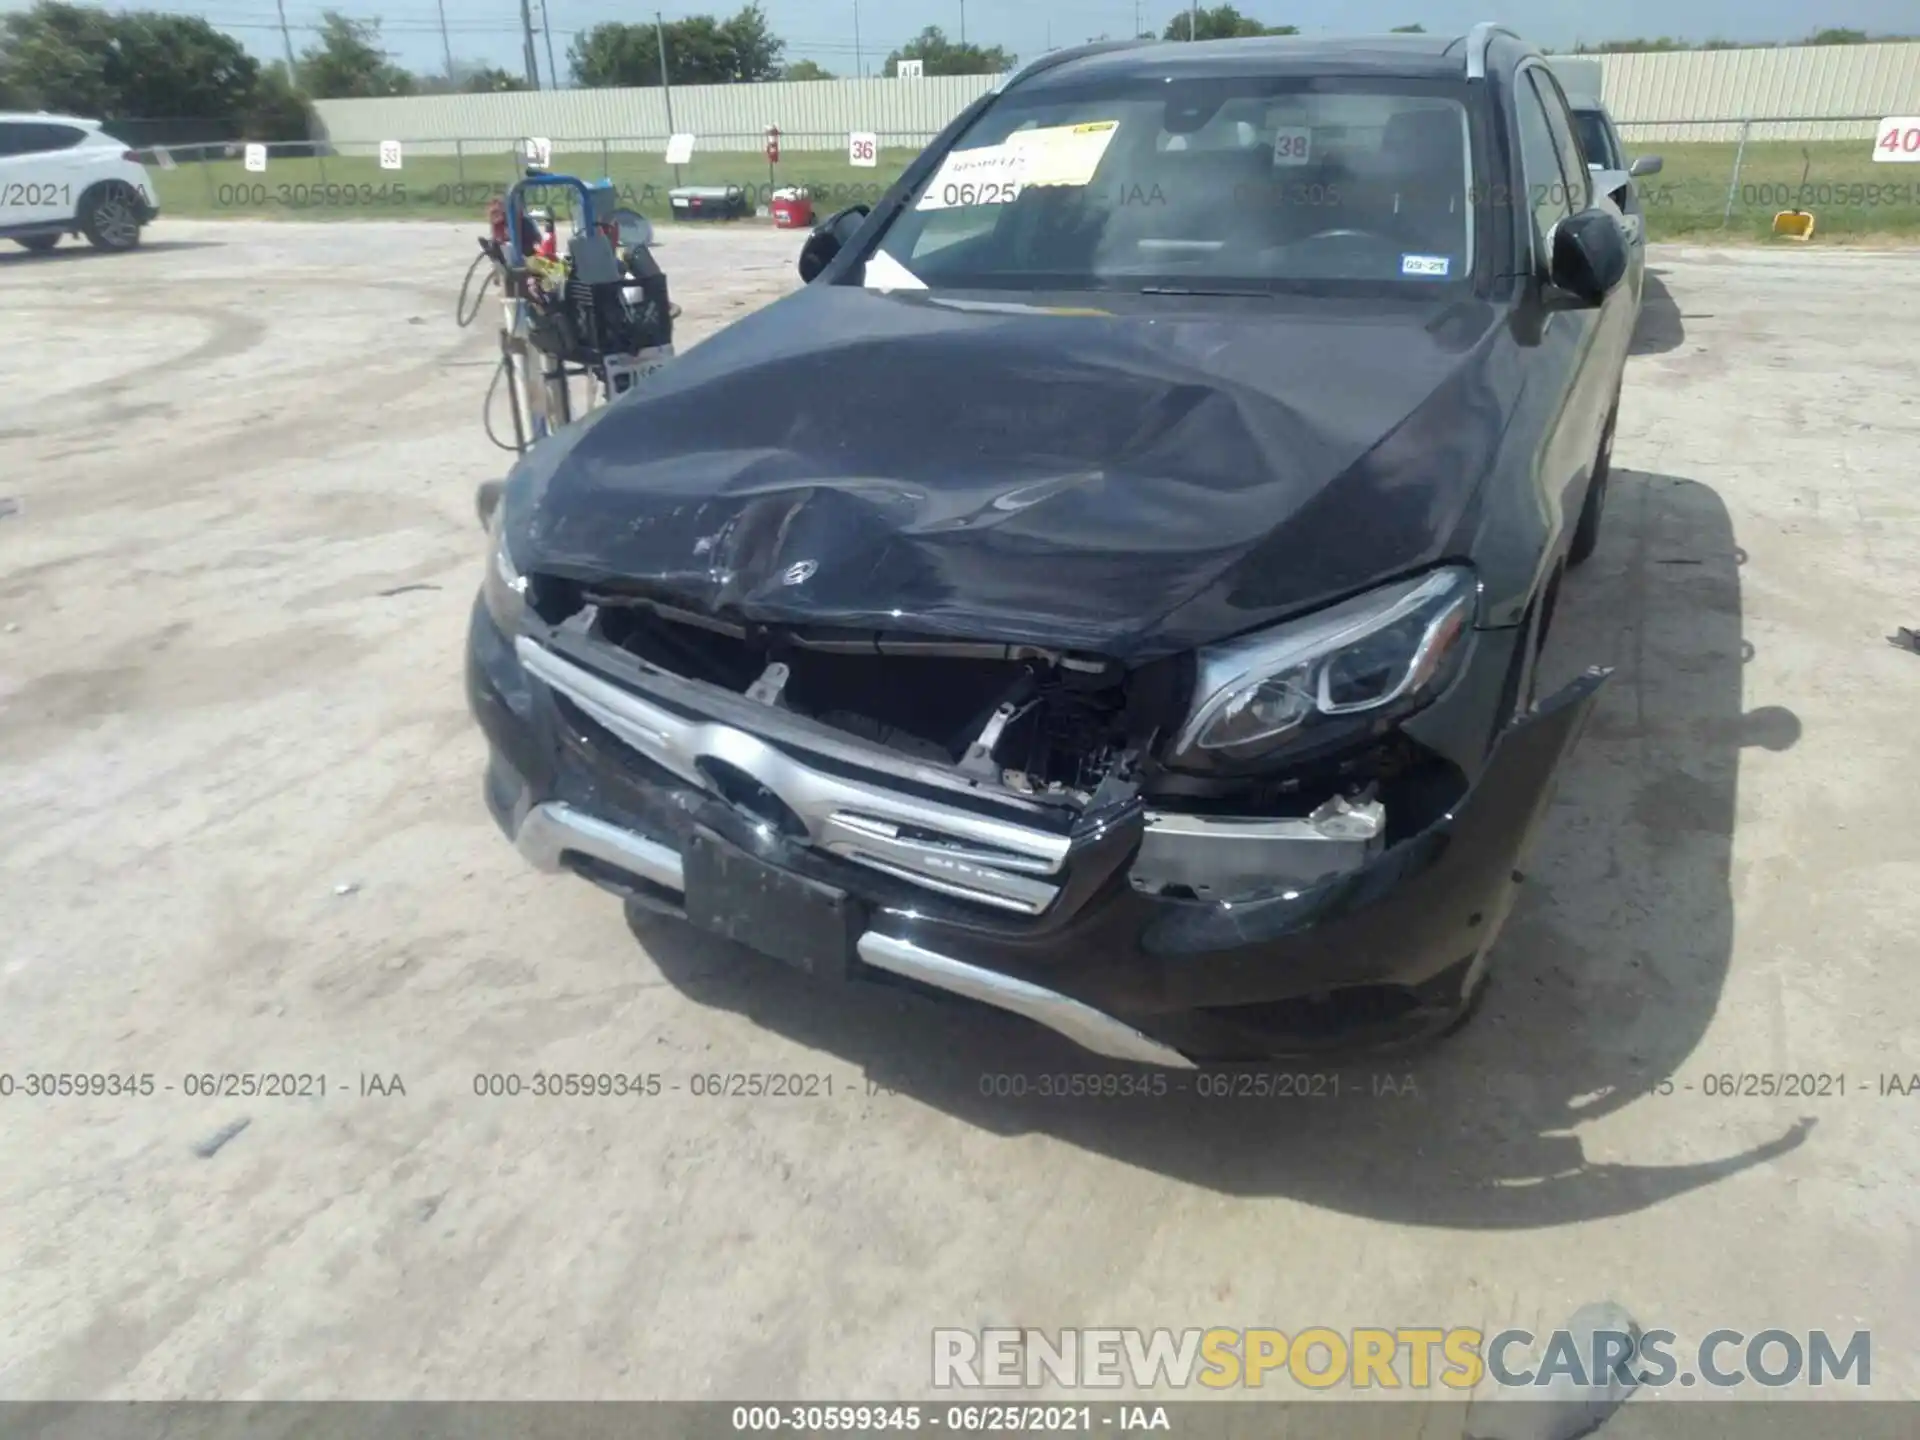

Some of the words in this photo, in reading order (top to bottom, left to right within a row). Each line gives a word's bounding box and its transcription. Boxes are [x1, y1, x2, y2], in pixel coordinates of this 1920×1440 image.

[853, 141, 873, 160] 36
[1277, 135, 1308, 158] 38
[1880, 128, 1920, 153] 40
